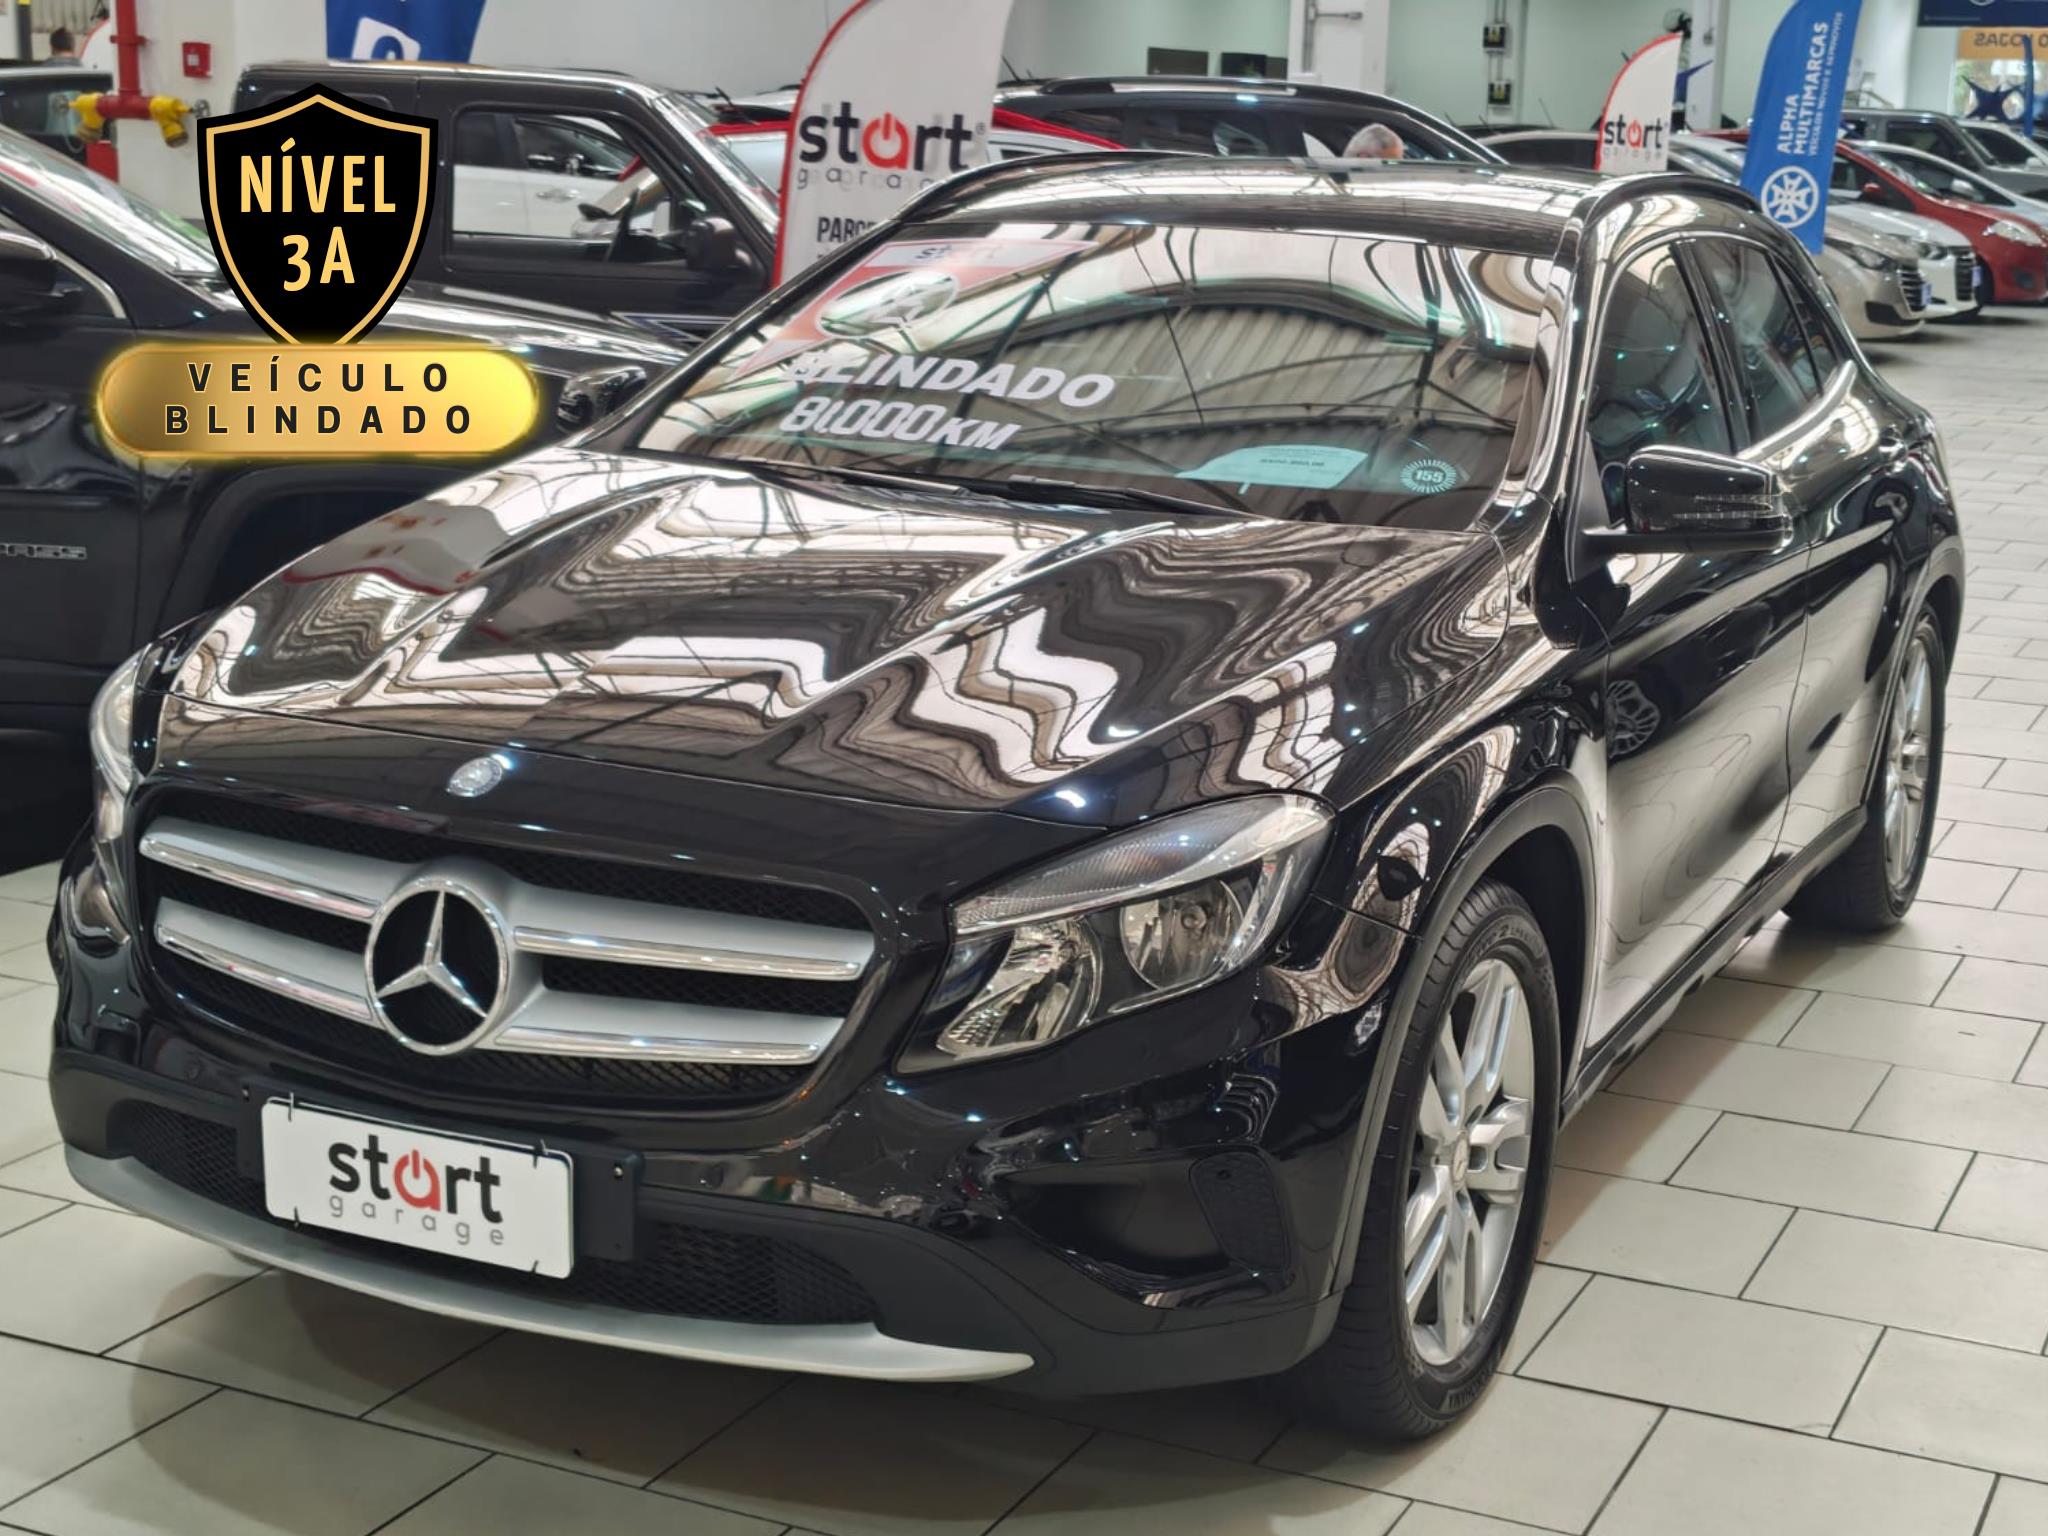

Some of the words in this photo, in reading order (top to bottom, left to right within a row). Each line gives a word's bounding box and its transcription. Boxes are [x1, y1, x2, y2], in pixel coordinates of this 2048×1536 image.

[1793, 22, 1829, 154] MULTIMARCAS
[799, 101, 972, 173] start
[1603, 114, 1663, 149] start
[1777, 94, 1799, 154] ALPHA
[328, 1134, 504, 1223] start
[329, 1194, 505, 1246] garage
